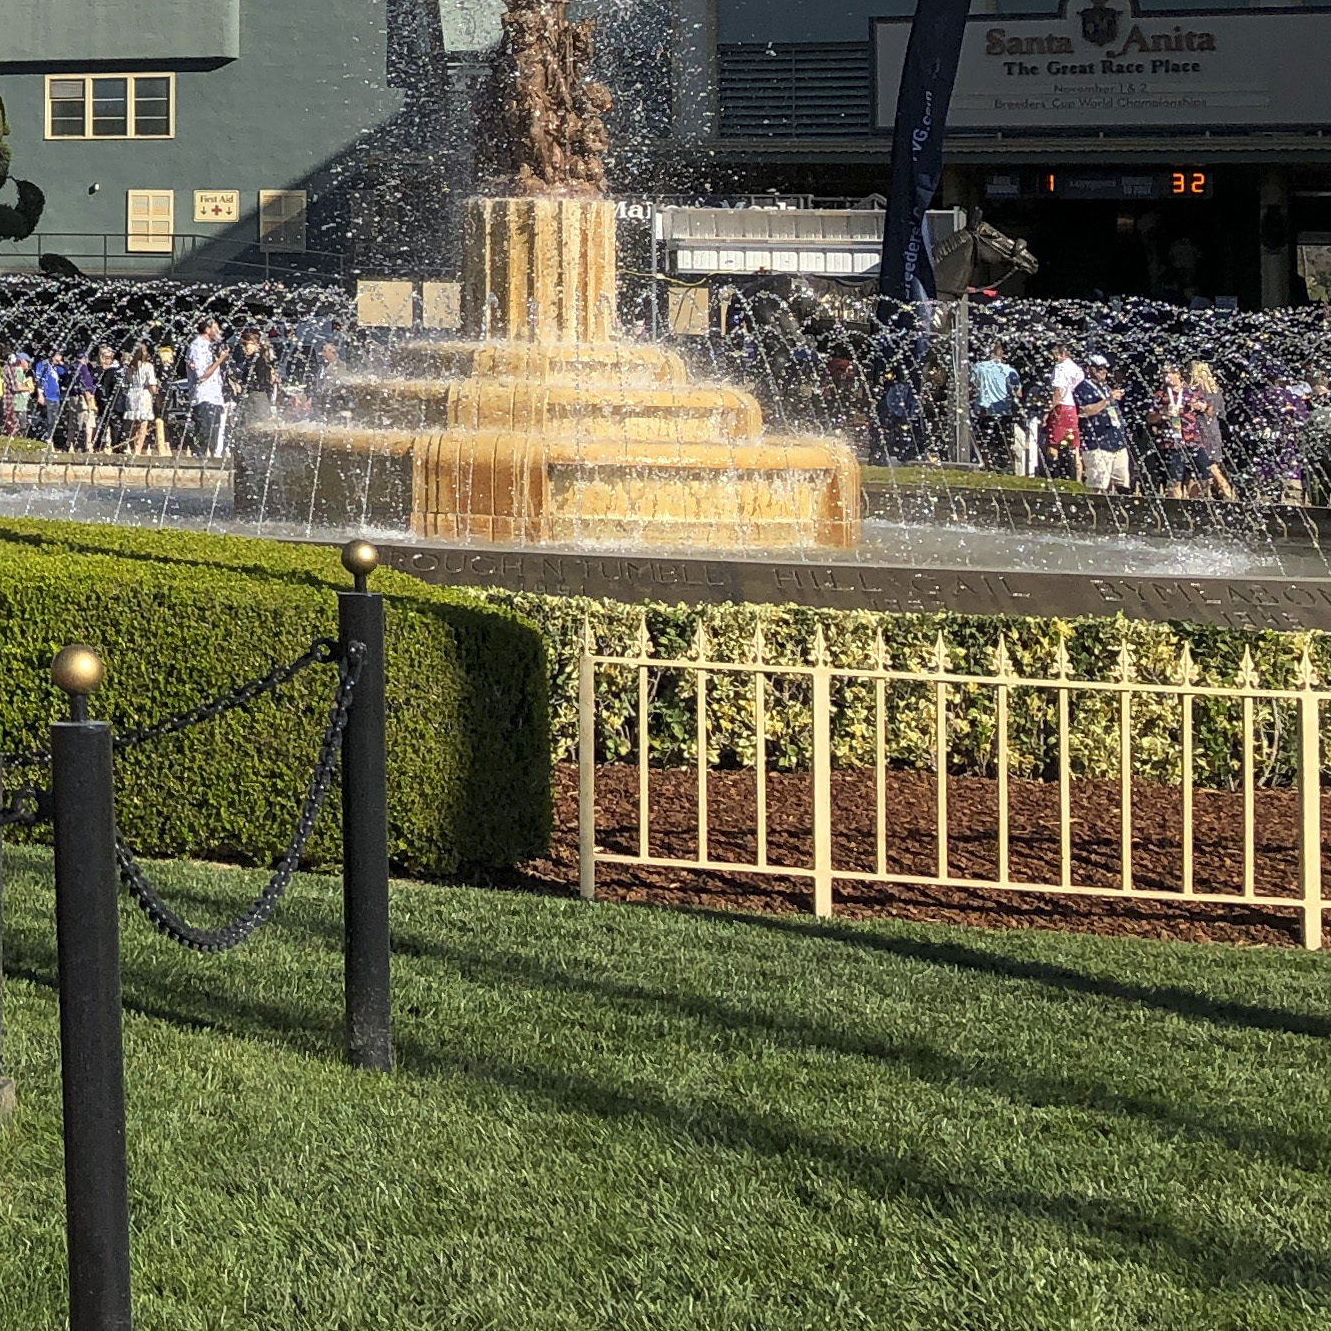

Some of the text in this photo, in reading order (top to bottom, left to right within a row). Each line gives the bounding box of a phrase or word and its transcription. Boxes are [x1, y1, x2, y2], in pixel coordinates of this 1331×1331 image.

[986, 24, 1216, 58] Santa Anita
[1003, 58, 1201, 76] The Great Race Place
[1054, 83, 1114, 94] November
[1140, 83, 1147, 93] 2
[1051, 98, 1076, 110] Cup
[1078, 97, 1113, 109] World
[1117, 97, 1207, 110] Championships
[1048, 174, 1055, 193] 1
[1172, 172, 1206, 194] 32
[200, 195, 234, 203] First Aid
